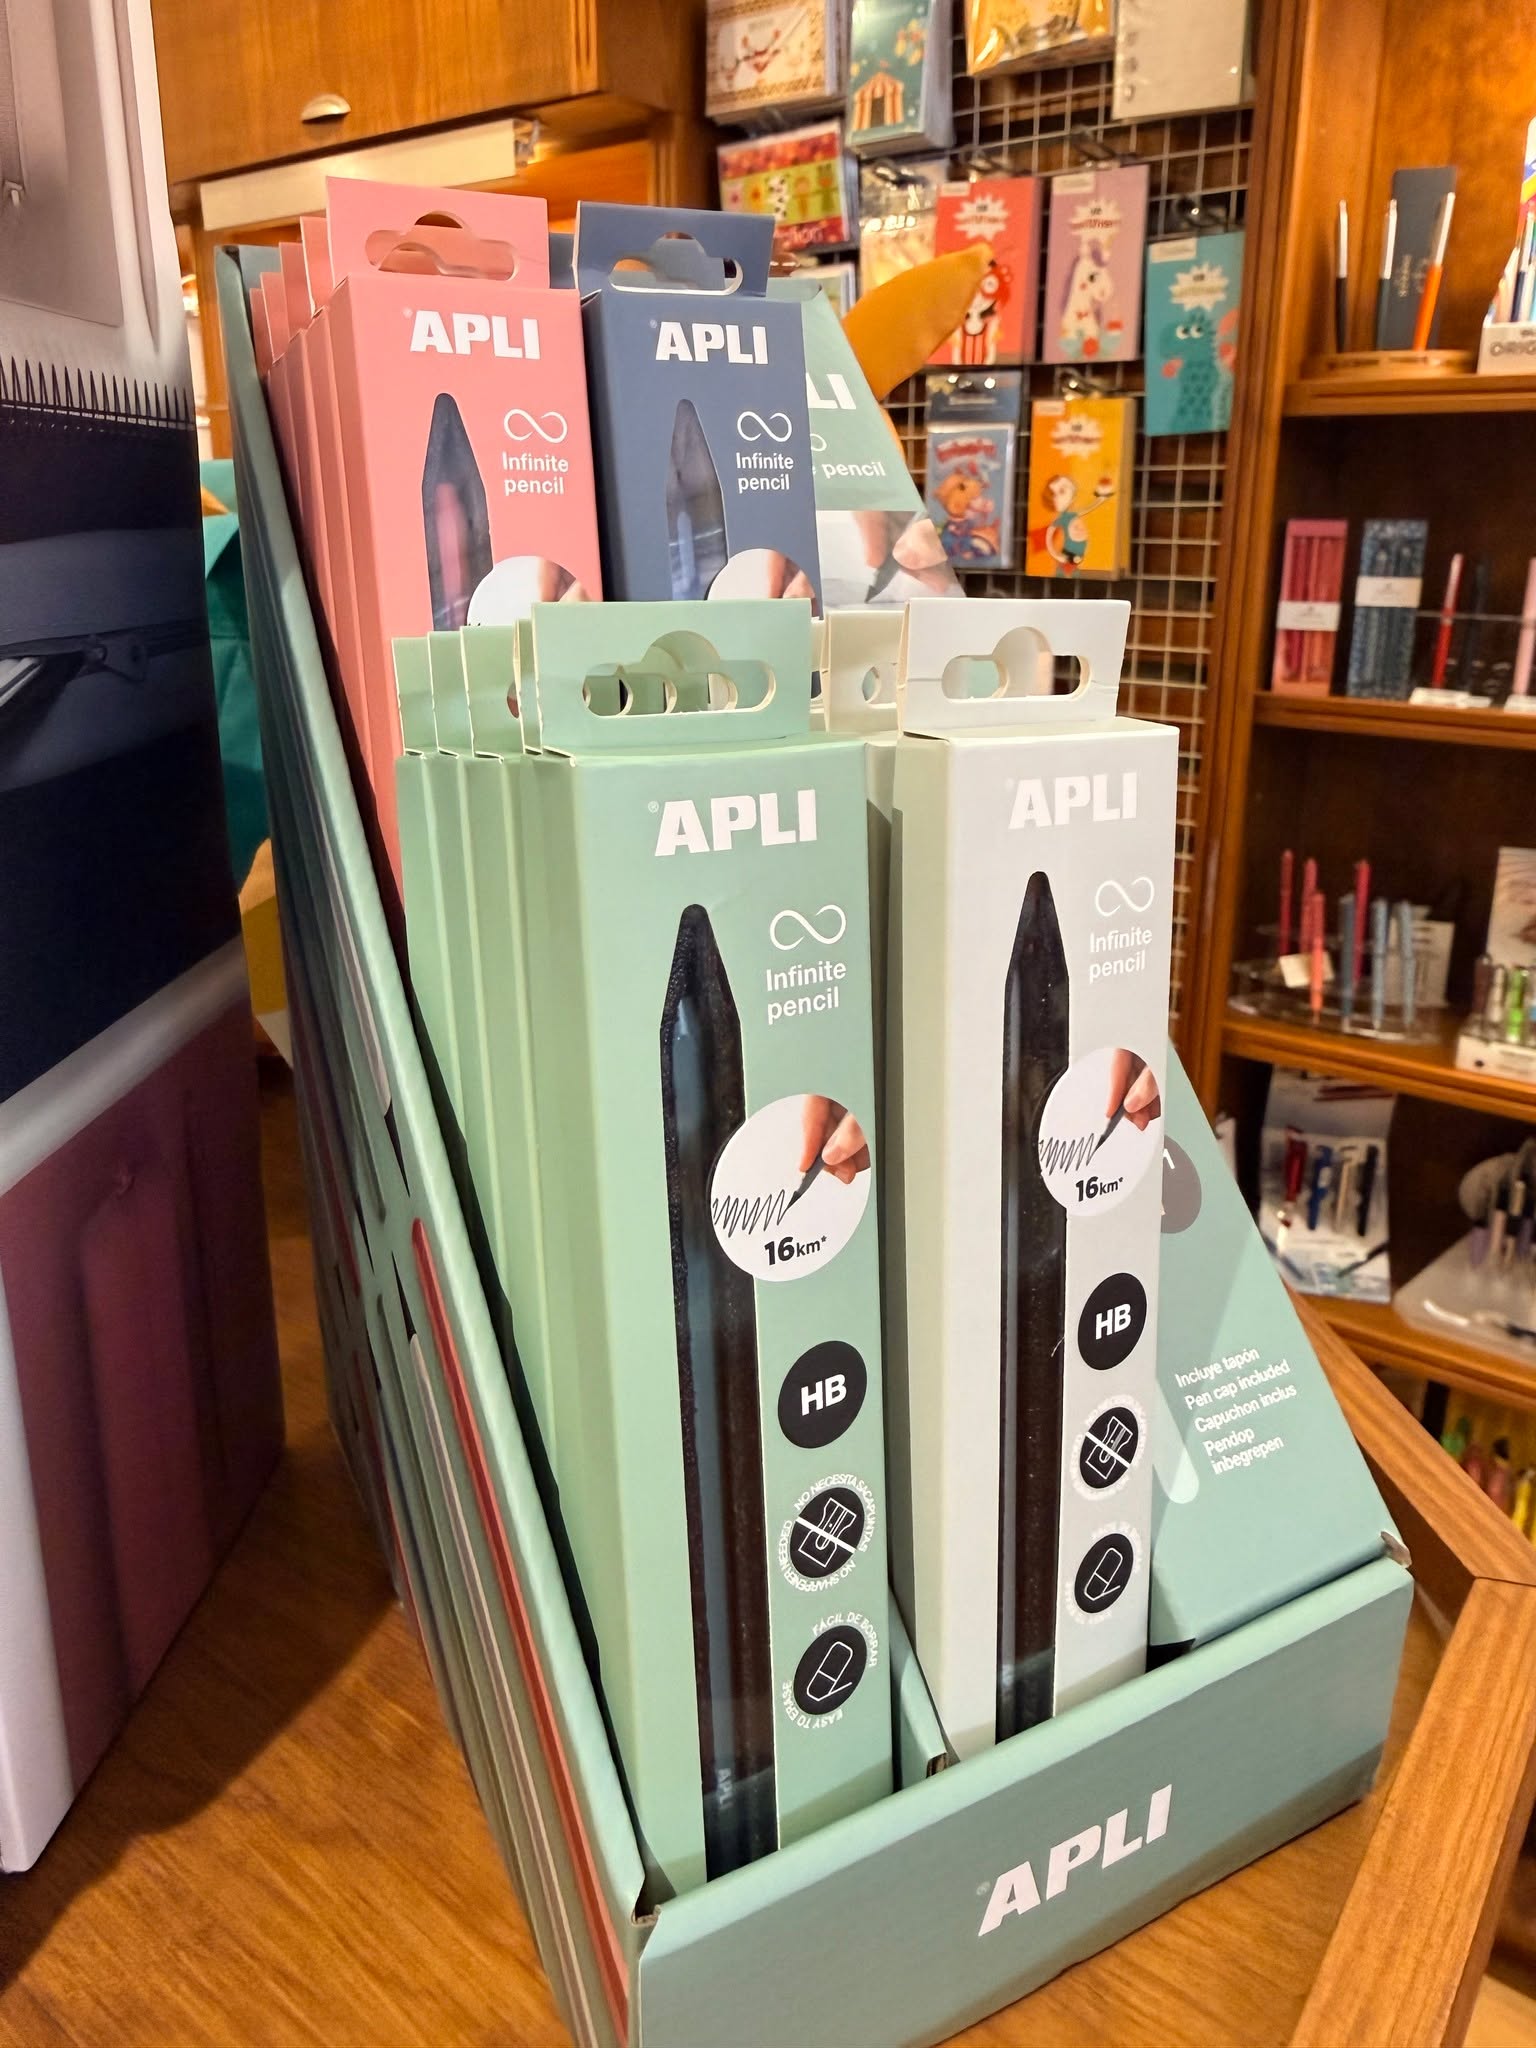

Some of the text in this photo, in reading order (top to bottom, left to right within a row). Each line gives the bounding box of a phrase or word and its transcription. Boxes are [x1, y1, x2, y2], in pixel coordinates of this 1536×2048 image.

[409, 309, 541, 360] APLI
[655, 321, 769, 365] APLI
[805, 372, 857, 410] LI
[502, 451, 569, 473] Infinite
[736, 452, 794, 470] Infinite
[821, 461, 886, 479] pencil
[503, 477, 565, 496] pencil
[737, 474, 790, 494] pencil
[1007, 771, 1138, 830] APLI
[654, 789, 818, 857] APLI
[1089, 926, 1153, 953] Infinite
[766, 960, 847, 992] Infinite
[1089, 950, 1146, 984] pencil
[767, 986, 840, 1026] pencil
[1095, 1303, 1132, 1340] HB
[1174, 1361, 1223, 1388] Incluye
[1184, 1358, 1291, 1410] Pen cap included
[800, 1373, 847, 1417] HB
[1194, 1384, 1298, 1433] Capuchon inclus
[1202, 1427, 1256, 1457] Pendop
[1210, 1436, 1285, 1475] inbegrepen
[793, 1491, 811, 1511] NO
[846, 1611, 863, 1625] DE
[797, 1715, 811, 1729] TO
[977, 1783, 1173, 1937] APLI
